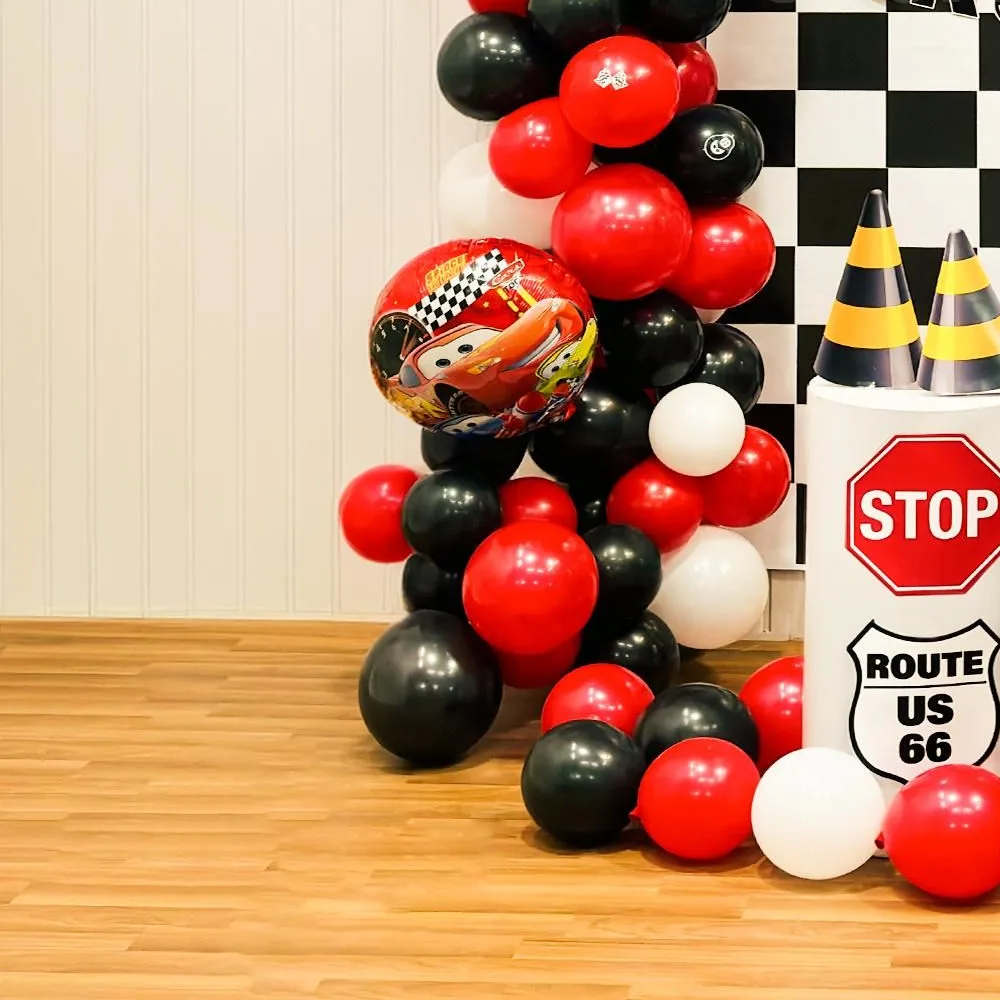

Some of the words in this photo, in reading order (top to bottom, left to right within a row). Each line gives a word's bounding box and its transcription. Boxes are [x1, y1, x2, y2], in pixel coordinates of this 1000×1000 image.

[859, 488, 999, 541] STOP
[866, 650, 984, 680] ROUTE
[897, 693, 954, 727] US
[898, 731, 953, 765] 66
